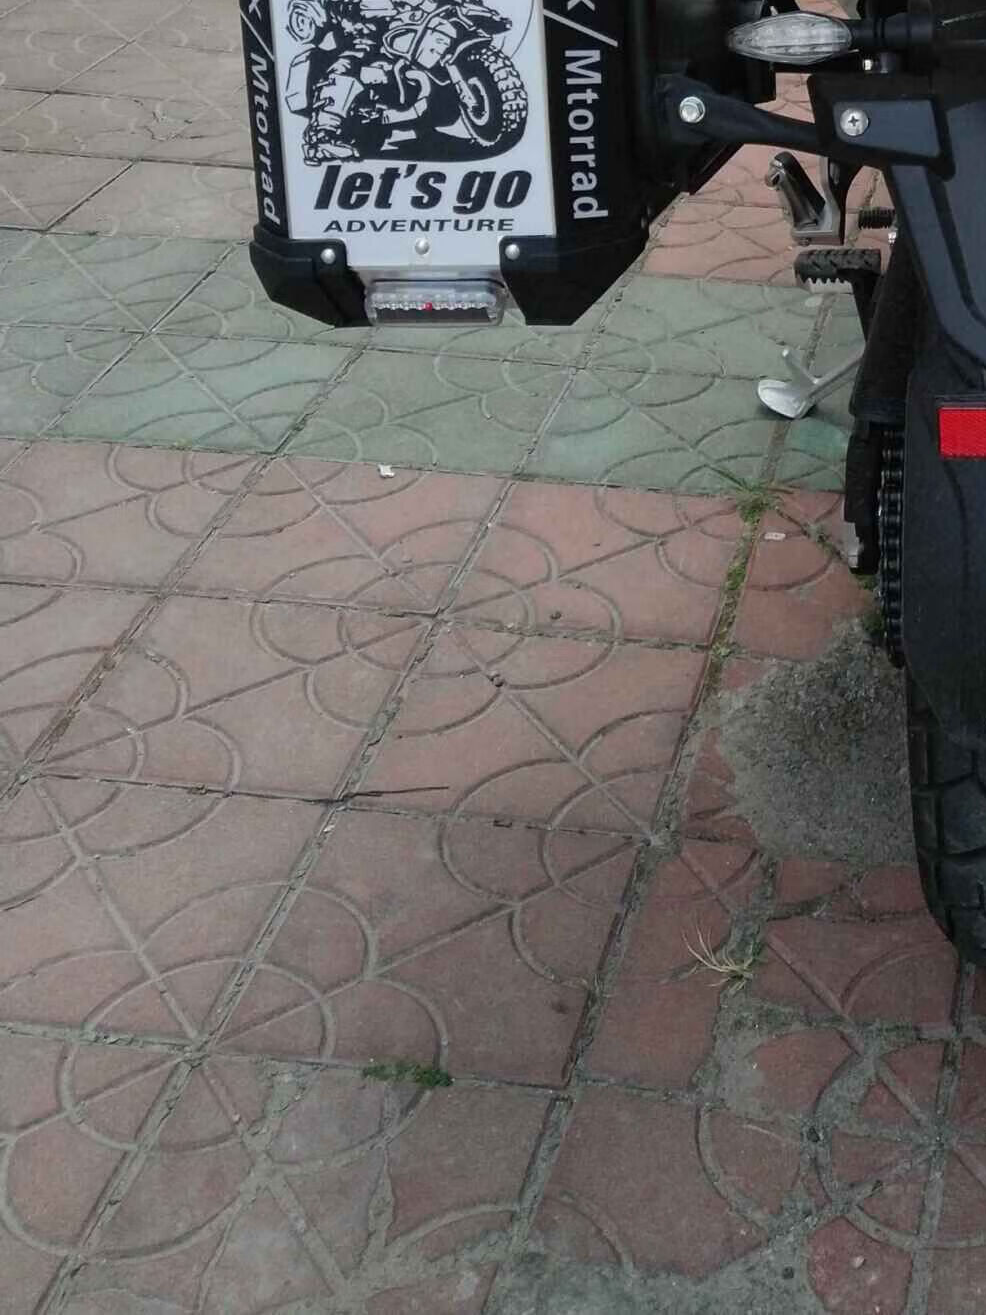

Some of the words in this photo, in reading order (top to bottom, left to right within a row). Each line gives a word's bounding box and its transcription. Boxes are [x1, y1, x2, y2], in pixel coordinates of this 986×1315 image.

[314, 164, 447, 211] let's
[453, 170, 533, 215] go
[323, 219, 515, 233] ADVENTURE
